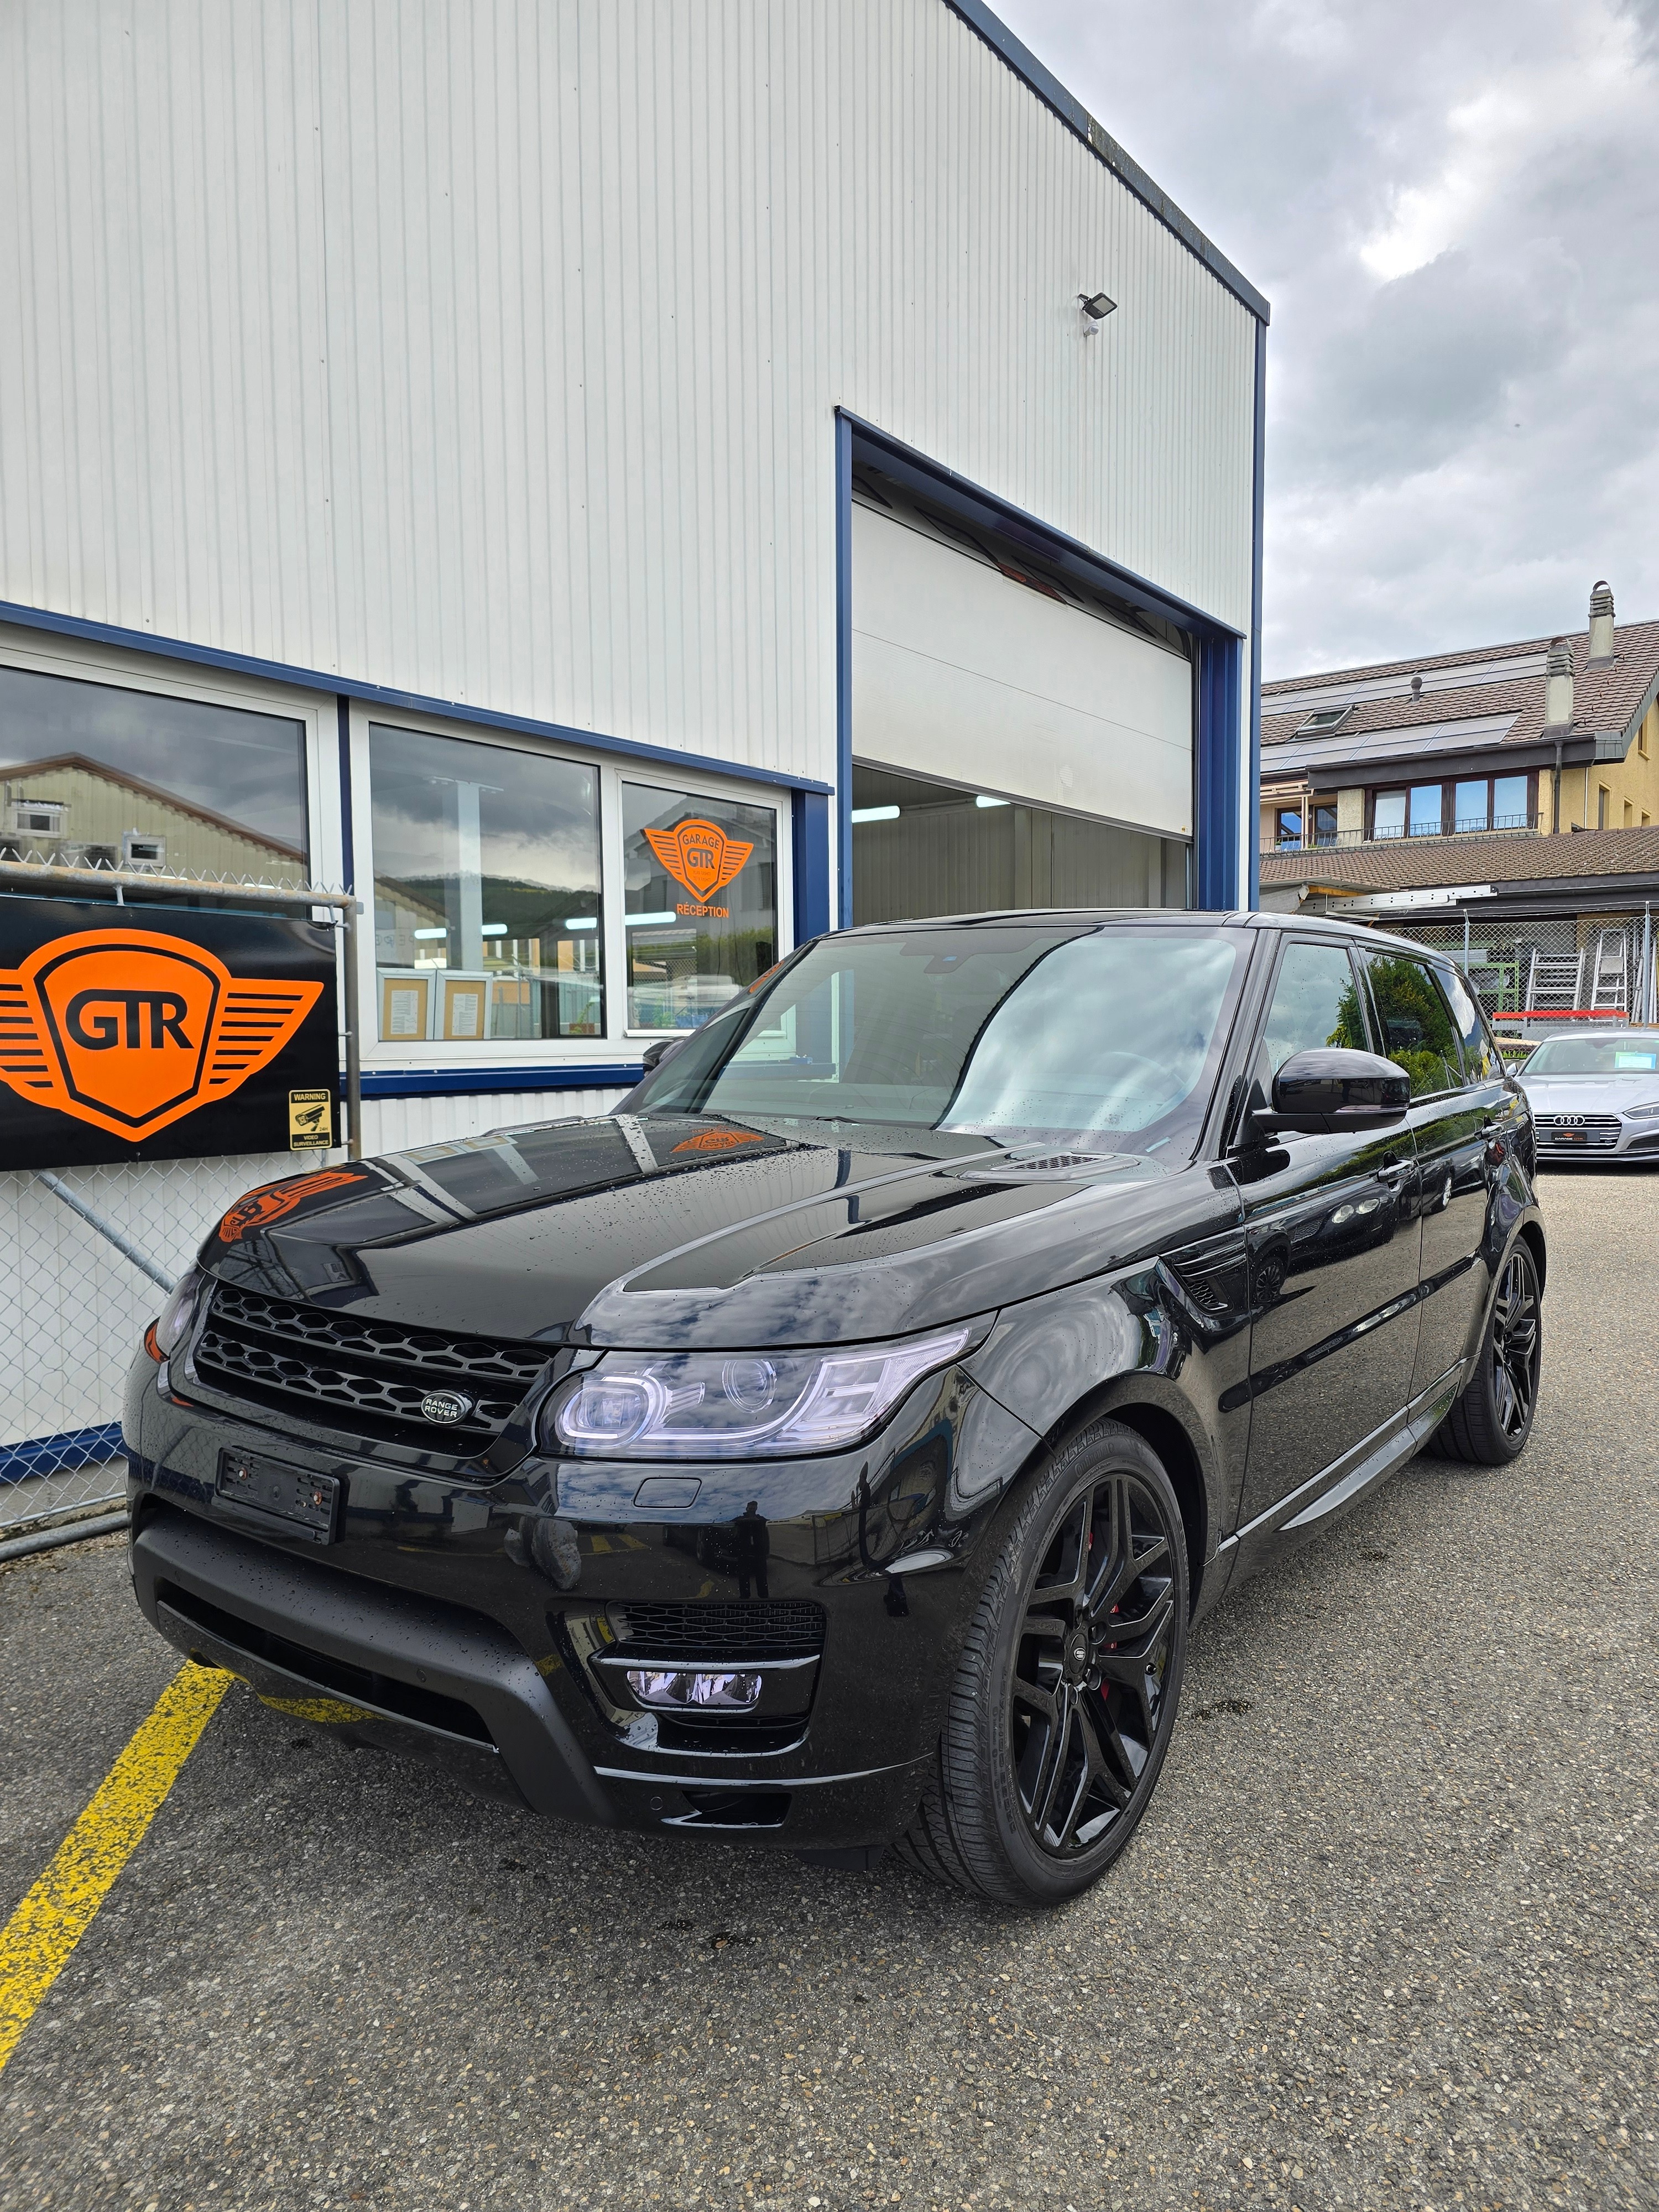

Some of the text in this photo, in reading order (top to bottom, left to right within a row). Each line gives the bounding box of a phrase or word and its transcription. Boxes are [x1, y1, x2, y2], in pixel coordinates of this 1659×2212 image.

[682, 833, 720, 850] GARAGE
[686, 847, 715, 869] GTR
[676, 901, 729, 918] RÉCEPTION
[65, 989, 195, 1050] GTR
[294, 1093, 326, 1101] WARNING
[424, 1405, 457, 1418] ROVER
[425, 1399, 458, 1411] RANGE
